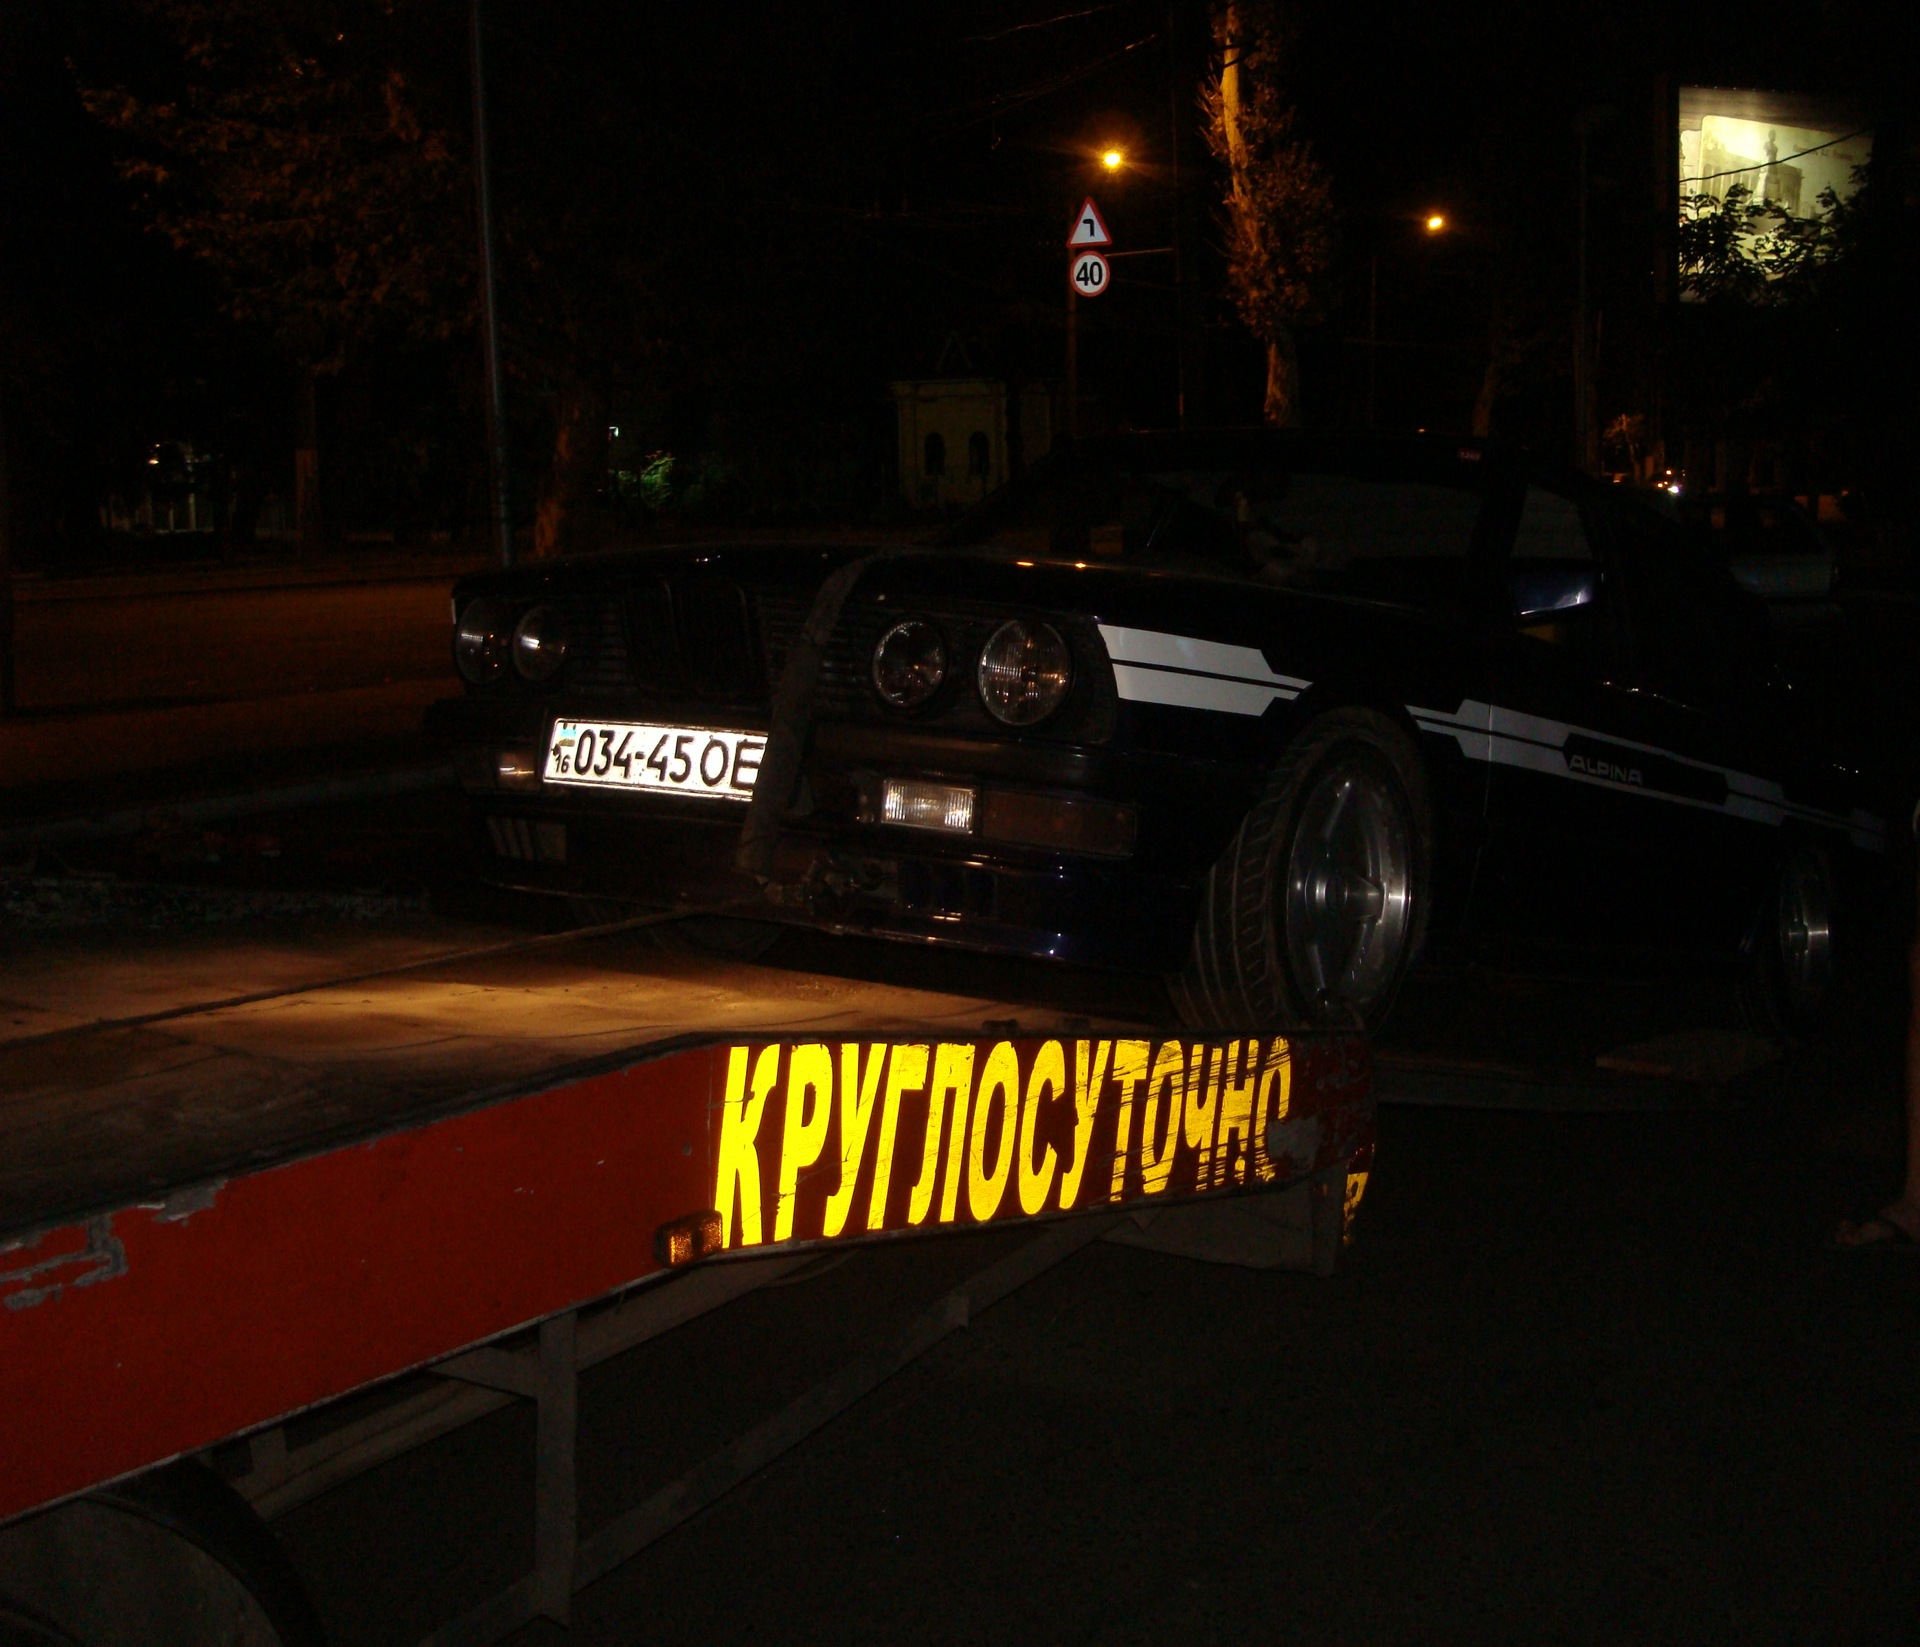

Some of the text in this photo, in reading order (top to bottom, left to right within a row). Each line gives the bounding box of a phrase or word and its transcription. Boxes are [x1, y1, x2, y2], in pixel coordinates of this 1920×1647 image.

[1075, 261, 1103, 287] 40
[554, 754, 571, 774] 16
[1569, 754, 1643, 786] ALPINA
